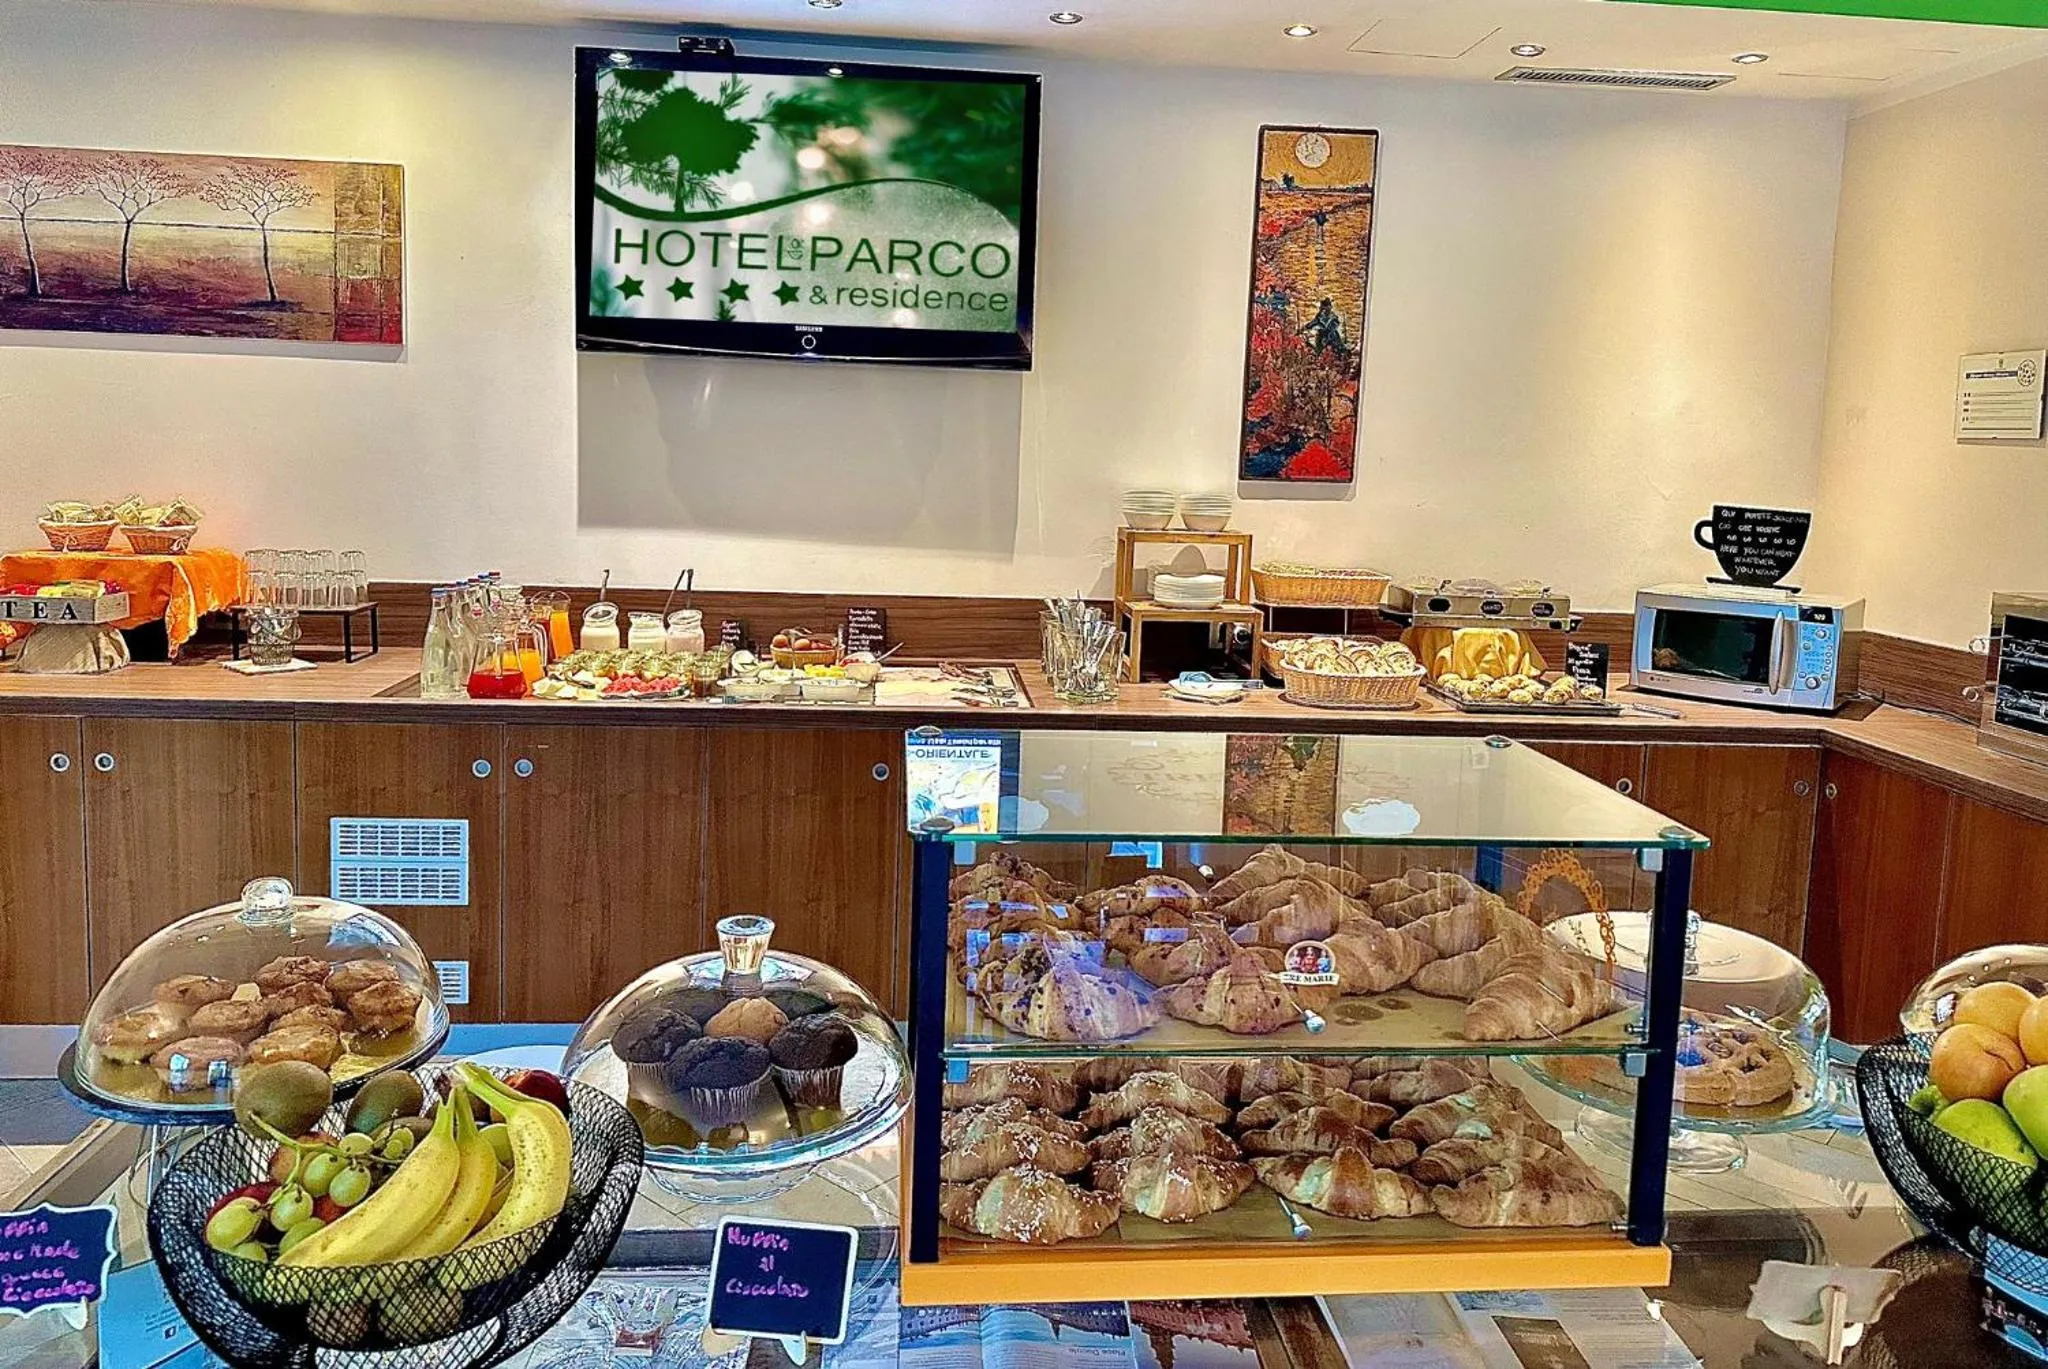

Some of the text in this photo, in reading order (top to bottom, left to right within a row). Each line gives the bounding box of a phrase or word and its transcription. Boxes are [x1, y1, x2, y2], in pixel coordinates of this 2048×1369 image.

[613, 227, 802, 272] HOTEL
[809, 236, 1012, 279] PARCO
[809, 281, 1009, 312] & residence
[1743, 546, 1760, 556] YOU
[1734, 565, 1754, 575] YOU
[1, 600, 79, 620] TEA
[1304, 975, 1334, 983] MARIE
